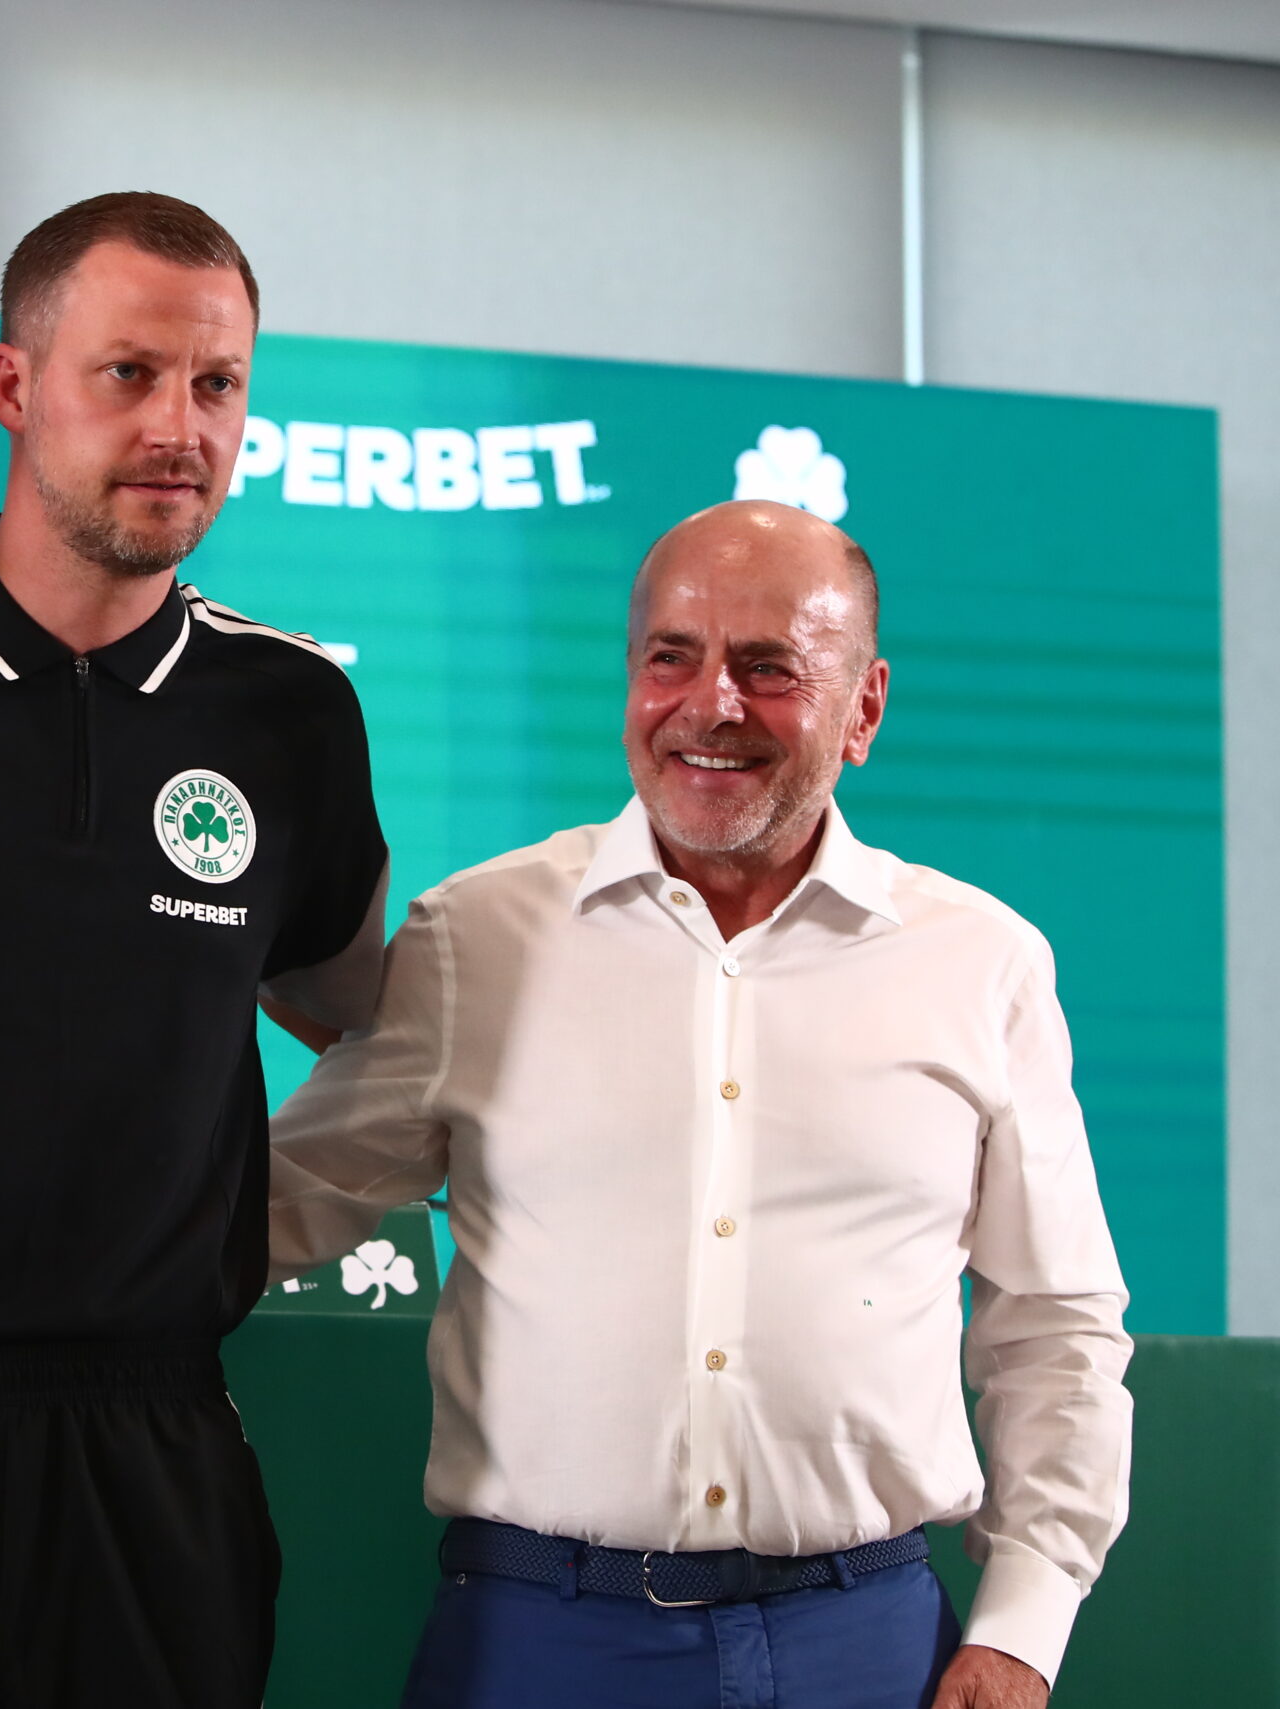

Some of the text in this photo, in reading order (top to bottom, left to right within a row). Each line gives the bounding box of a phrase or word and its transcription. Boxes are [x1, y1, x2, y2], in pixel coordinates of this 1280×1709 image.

[227, 415, 597, 510] PERBET
[194, 857, 222, 873] 1908
[149, 894, 248, 926] SUPERBET
